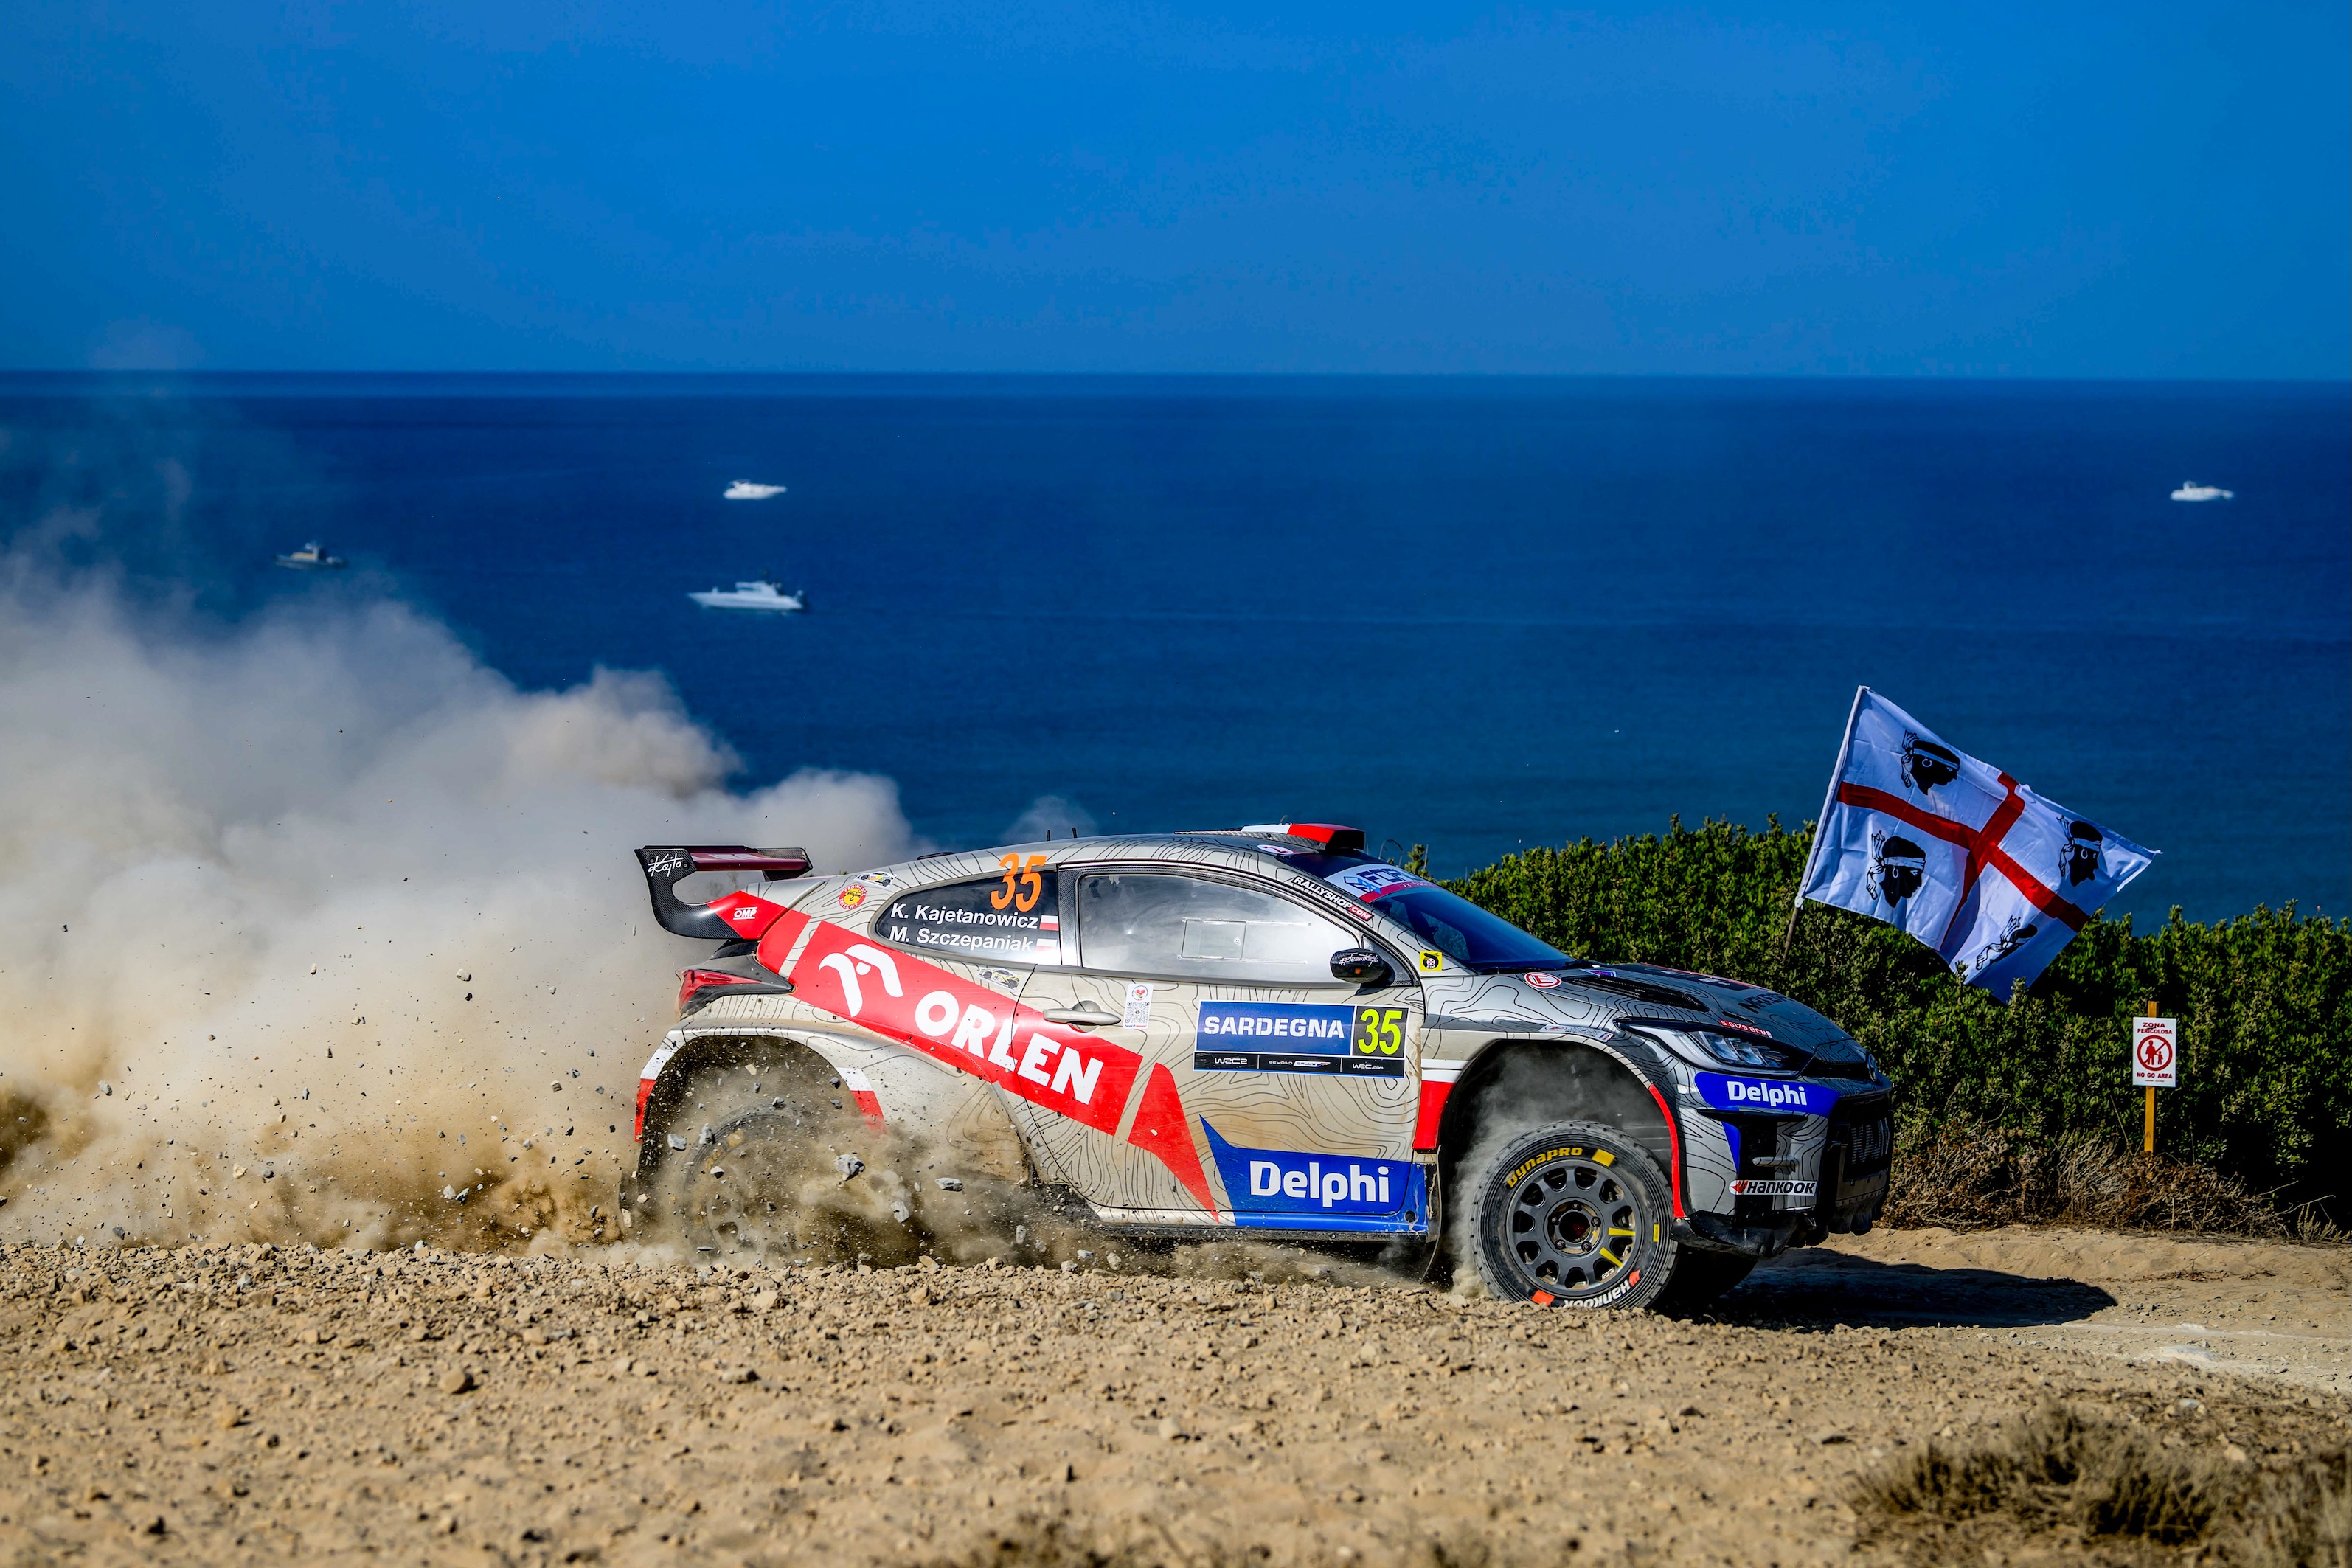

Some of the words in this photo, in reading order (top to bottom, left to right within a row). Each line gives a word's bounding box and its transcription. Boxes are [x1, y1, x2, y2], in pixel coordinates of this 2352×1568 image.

[991, 853, 1047, 912] 35
[1293, 875, 1372, 920] RALLYSHOP.COM
[733, 908, 757, 919] OMP
[890, 903, 909, 920] K.
[915, 904, 1039, 929] Kajetanowicz
[889, 926, 909, 943] M.
[916, 928, 1033, 951] Szczepaniak
[1204, 1016, 1345, 1038] SARDEGNA
[1357, 1008, 1403, 1055] 35
[915, 991, 1104, 1106] ORLEN
[1727, 1081, 1808, 1107] Delphi
[1249, 1160, 1390, 1208] Delphi
